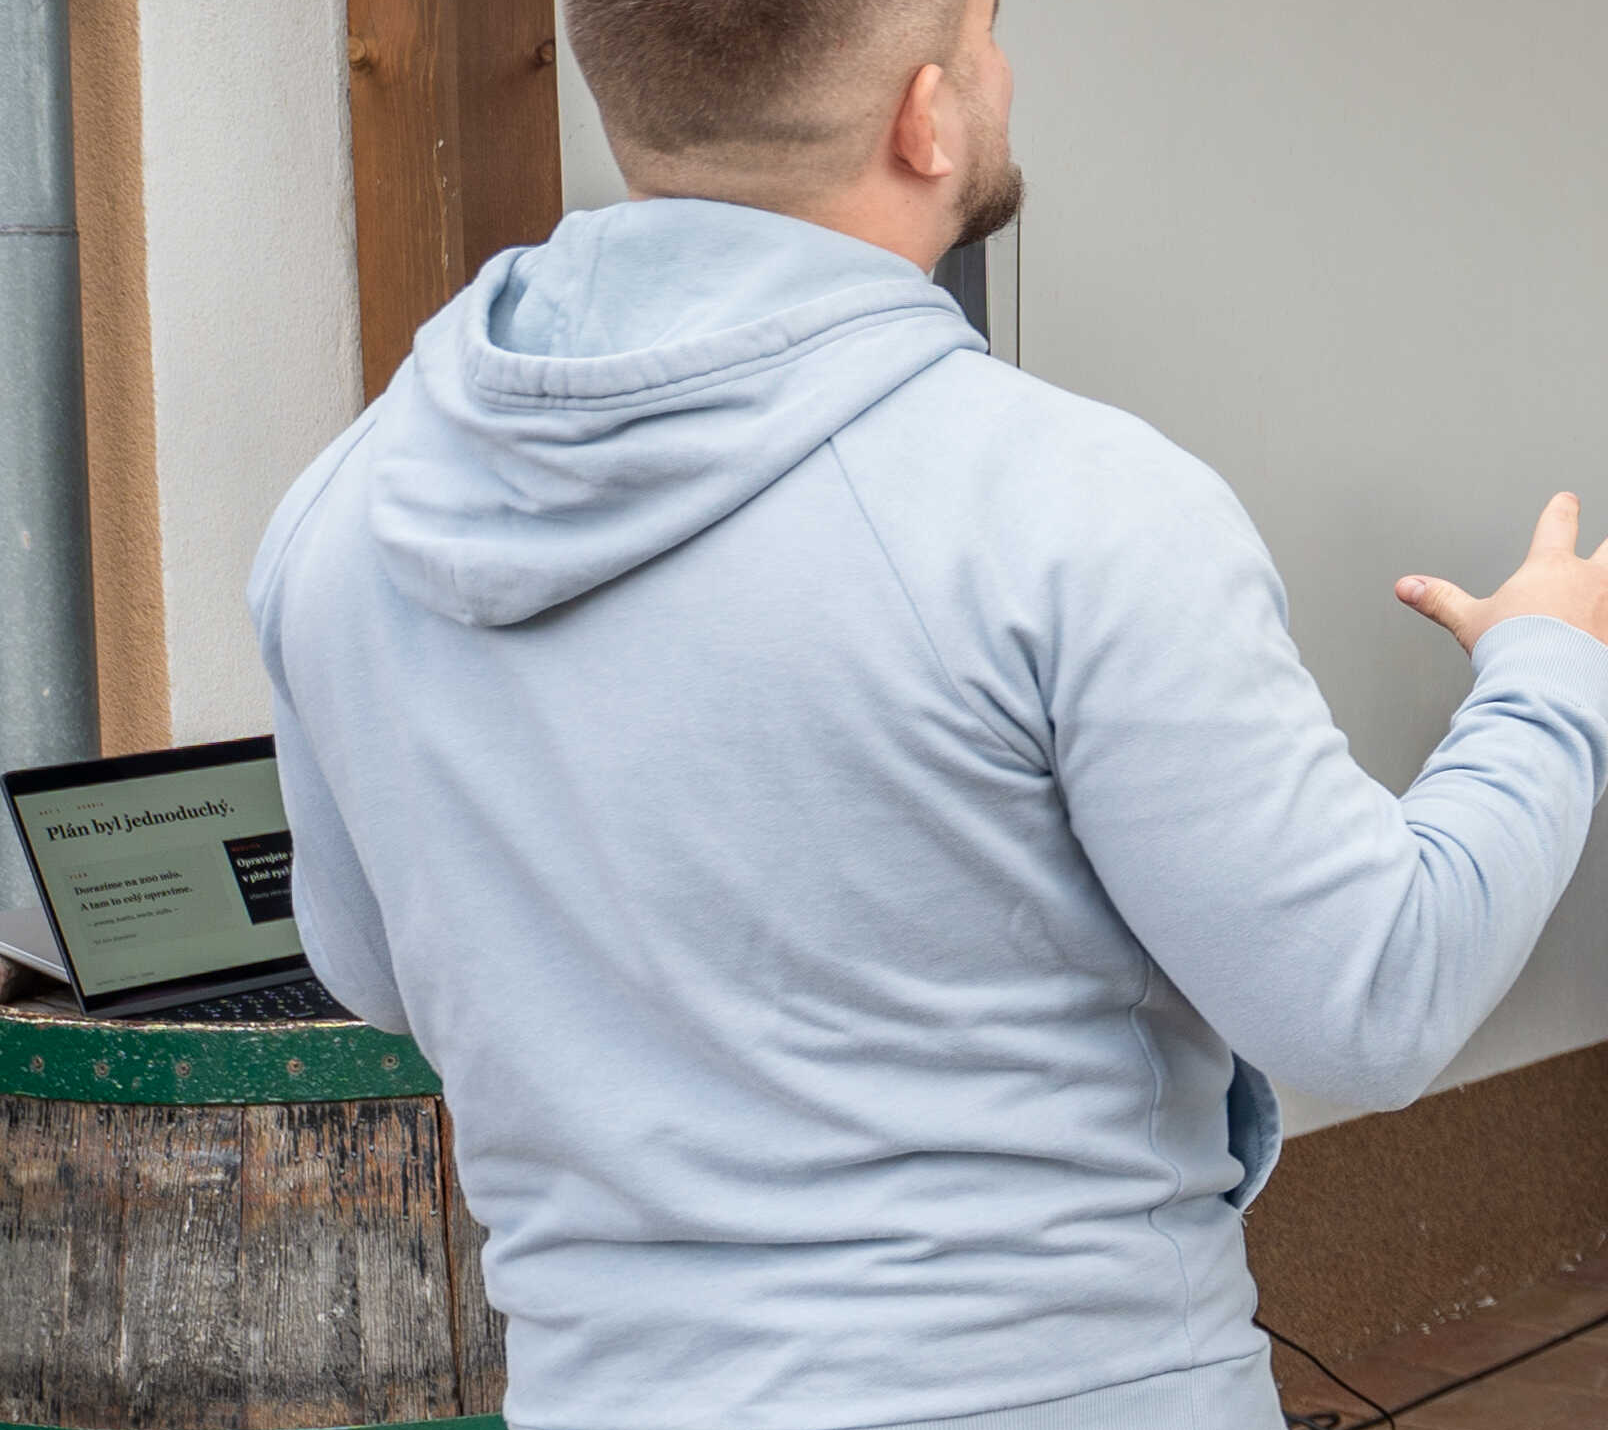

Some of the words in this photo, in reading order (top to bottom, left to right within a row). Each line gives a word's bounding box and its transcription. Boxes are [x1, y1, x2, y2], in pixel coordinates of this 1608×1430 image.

[46, 821, 90, 842] Plán
[91, 815, 122, 836] byl
[123, 798, 235, 833] jednoduchý.
